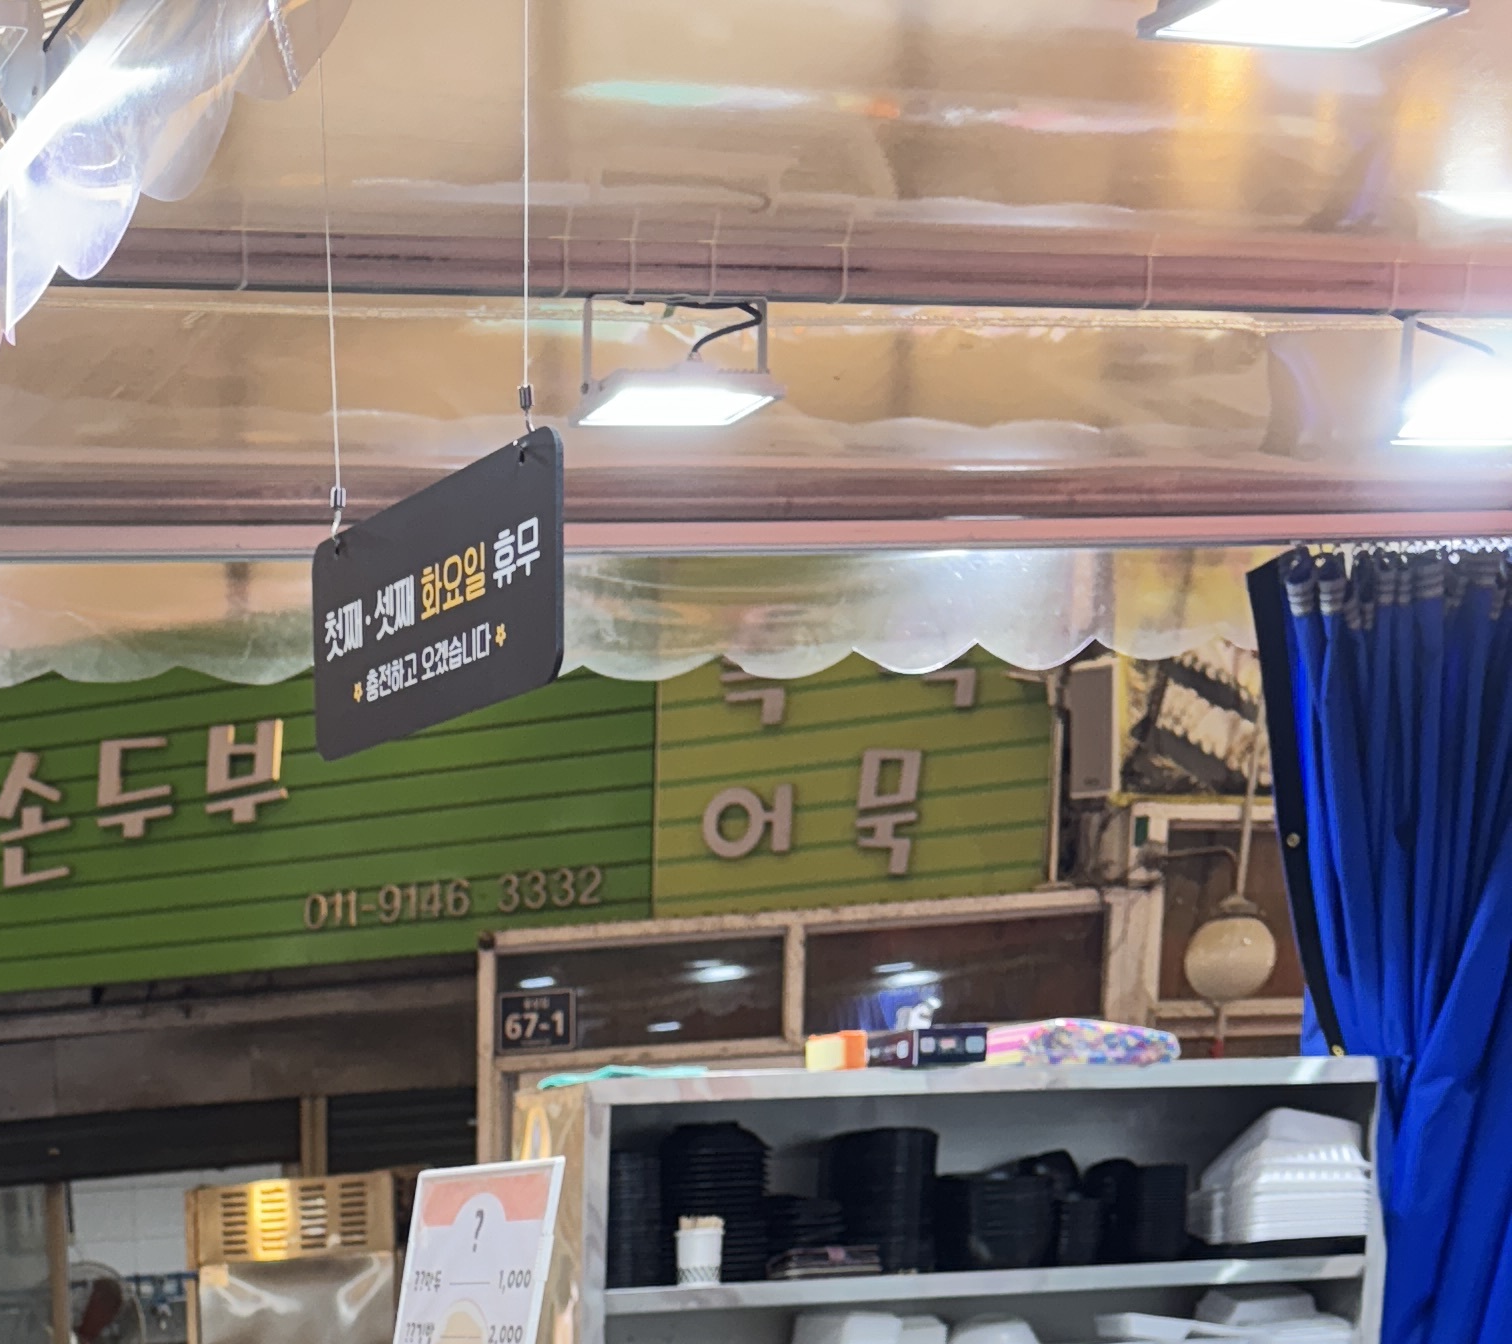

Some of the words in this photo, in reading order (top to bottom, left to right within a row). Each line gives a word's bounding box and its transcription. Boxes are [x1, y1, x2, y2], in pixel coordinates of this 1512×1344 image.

[420, 540, 487, 621] 화요일
[492, 515, 542, 589] 휴무
[365, 652, 419, 703] 충전하고
[421, 621, 492, 682] 오겠습니다
[702, 748, 923, 876] 어묵
[303, 878, 472, 930] 011-9146
[497, 865, 603, 913] 3332
[504, 1009, 565, 1041] 67-1
[498, 1268, 532, 1294] 1,000
